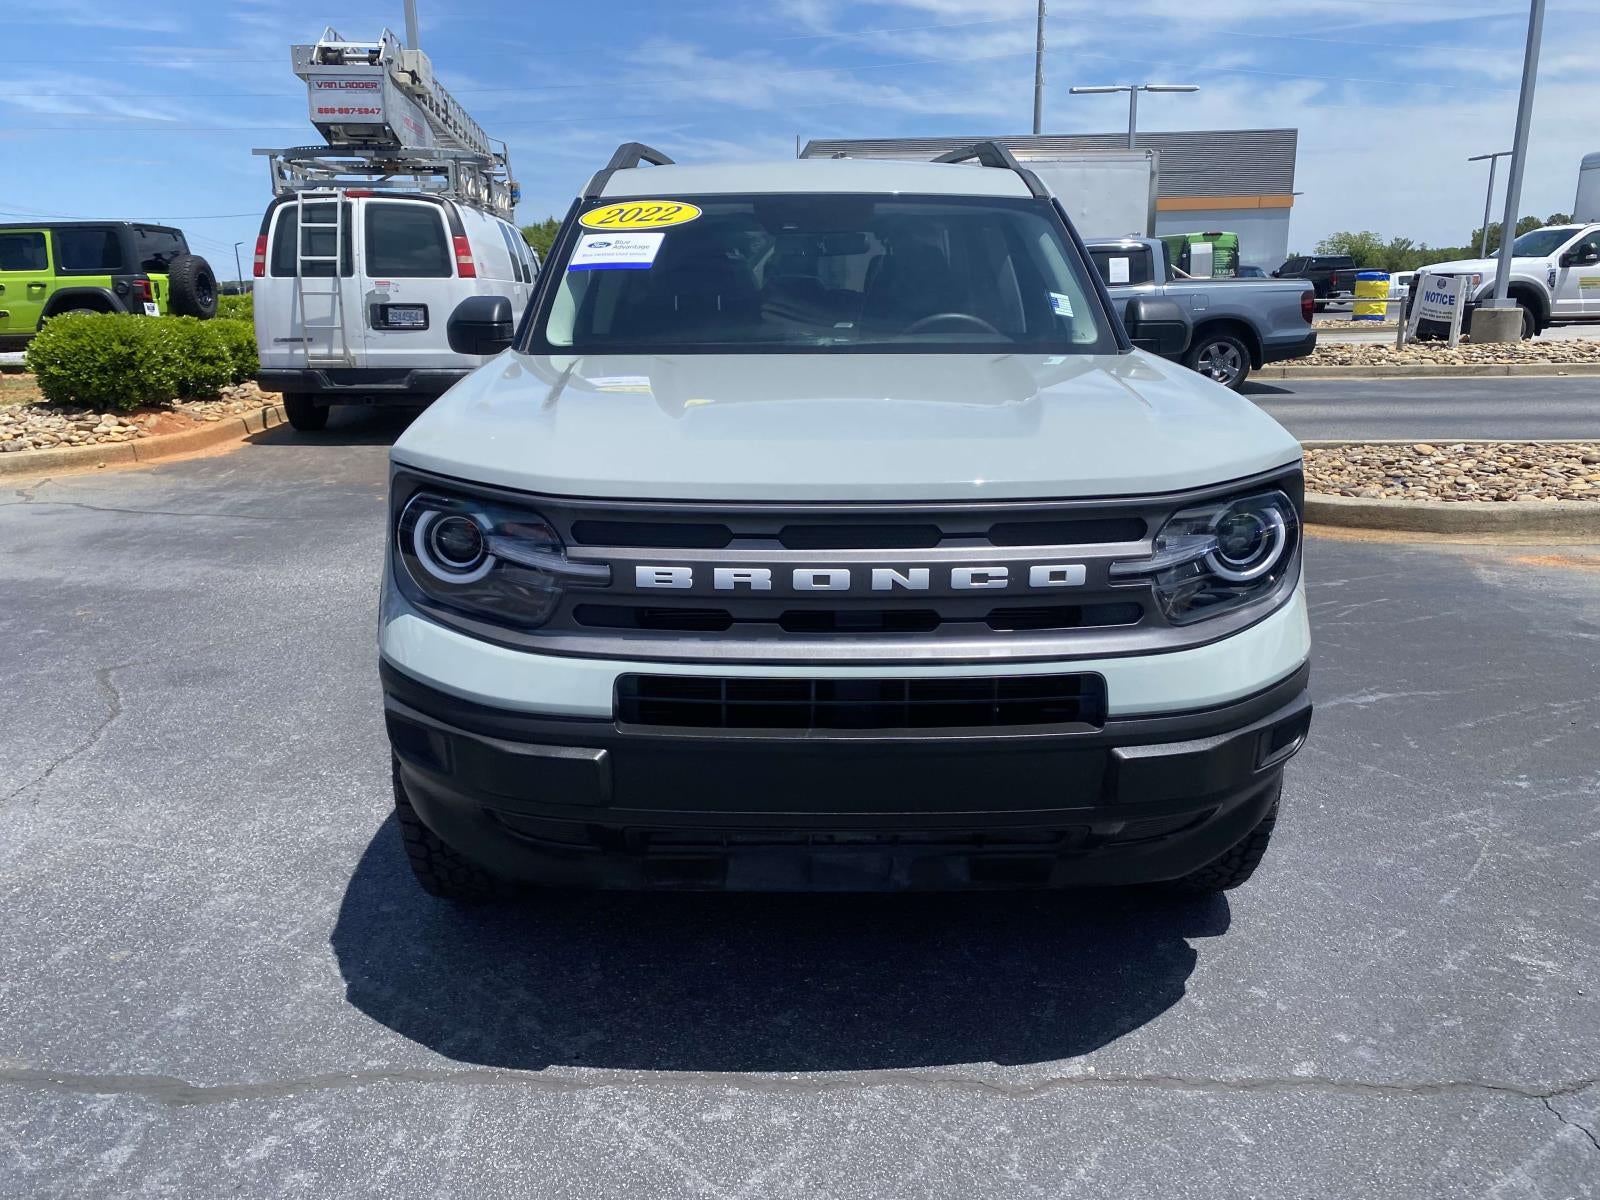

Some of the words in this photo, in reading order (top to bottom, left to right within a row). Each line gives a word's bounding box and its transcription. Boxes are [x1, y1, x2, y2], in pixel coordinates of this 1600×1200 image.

[316, 81, 338, 89] VAN
[597, 206, 683, 225] 2022
[1424, 291, 1456, 306] NOTICE
[635, 564, 1087, 591] BRONCO
